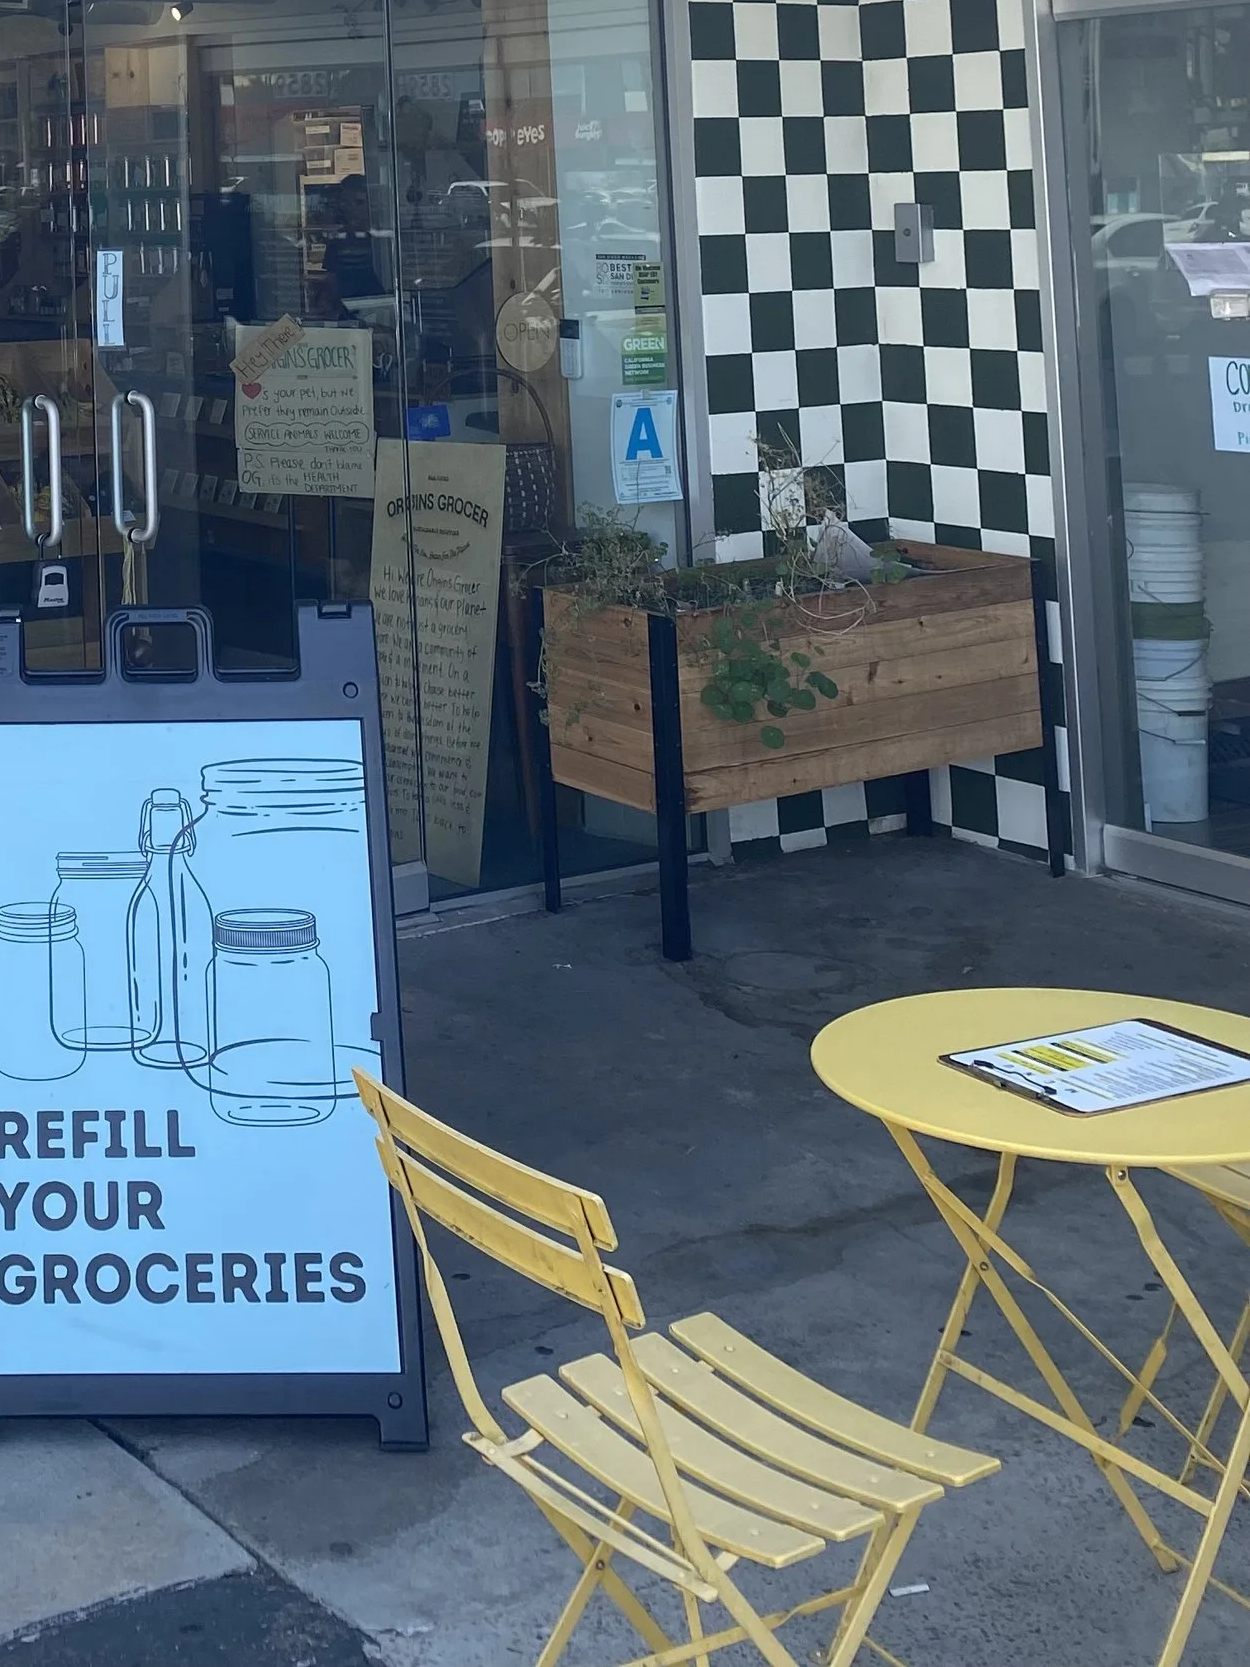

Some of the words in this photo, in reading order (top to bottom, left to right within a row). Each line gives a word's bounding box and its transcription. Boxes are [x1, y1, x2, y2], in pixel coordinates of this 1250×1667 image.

[609, 263, 632, 272] BEST
[610, 272, 624, 280] SAN
[102, 252, 120, 345] PULL
[503, 322, 550, 343] OPEN
[623, 336, 665, 351] GREEN
[234, 350, 269, 379] Hey
[274, 388, 296, 403] your
[321, 385, 337, 397] but
[276, 405, 296, 421] they
[283, 428, 319, 440] ANIMALS
[324, 428, 362, 440] WELCOME
[626, 407, 664, 461] A
[303, 472, 341, 482] HEALTH
[437, 493, 490, 528] GROCER
